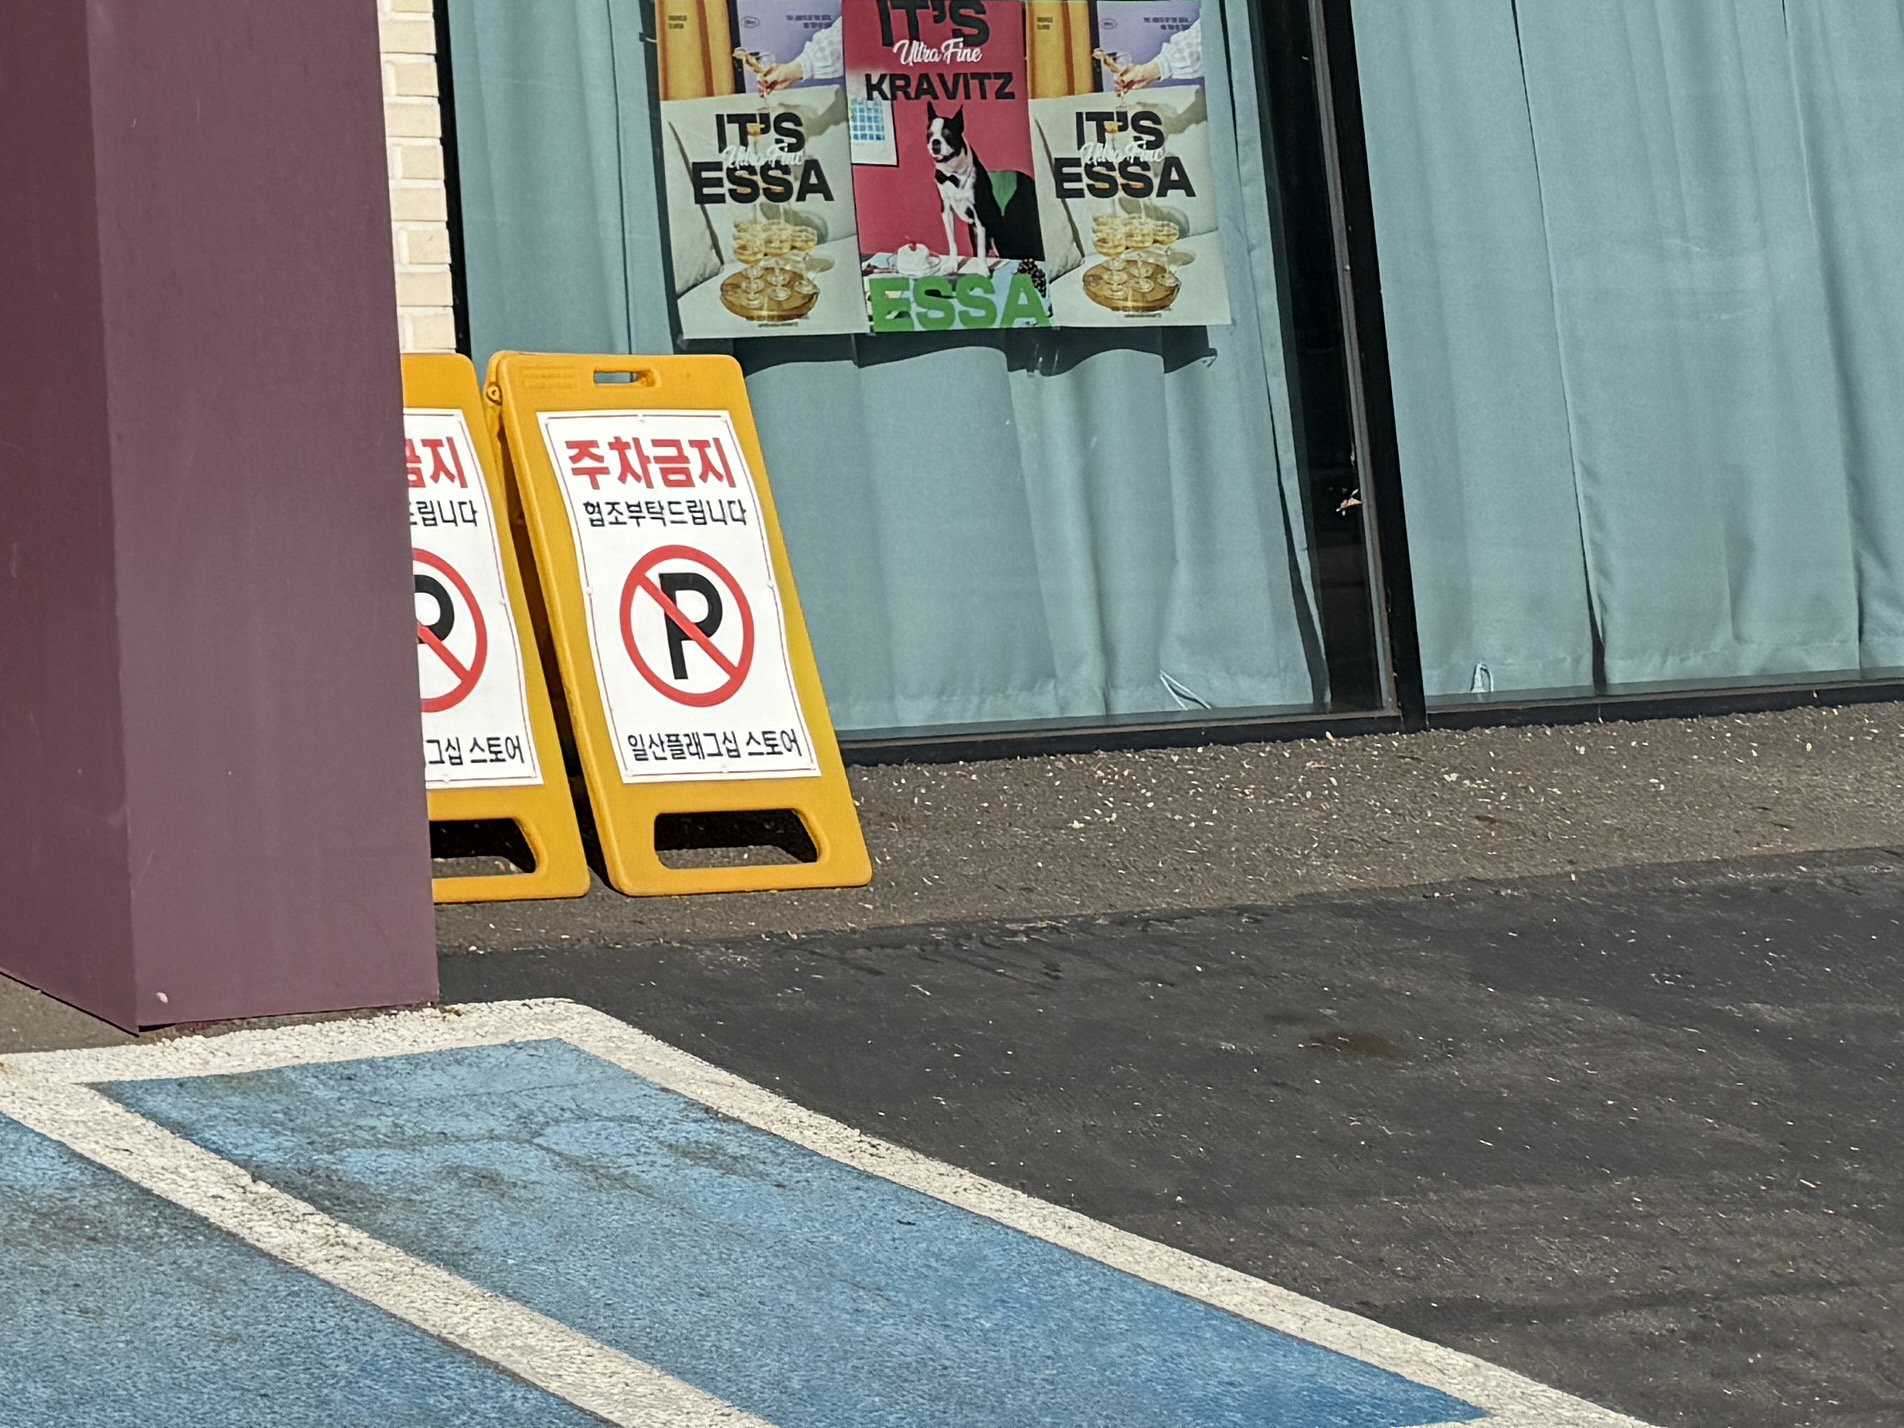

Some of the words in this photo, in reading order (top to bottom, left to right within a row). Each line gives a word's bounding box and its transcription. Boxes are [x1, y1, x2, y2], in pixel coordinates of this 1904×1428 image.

[893, 39, 942, 66] Ultra
[942, 37, 983, 65] Fine
[865, 72, 1016, 101] KRAVITZ
[715, 112, 805, 153] IT'S
[1075, 110, 1165, 151] IT'S
[692, 159, 835, 204] ESSA
[1054, 156, 1196, 199] ESSA
[870, 272, 1052, 332] ESSA
[565, 436, 737, 490] 주차금지
[582, 498, 748, 527] 협조부탁드립니다
[469, 734, 525, 764] 스토어
[627, 730, 742, 762] 일산플래그십
[745, 728, 803, 758] 스토어
